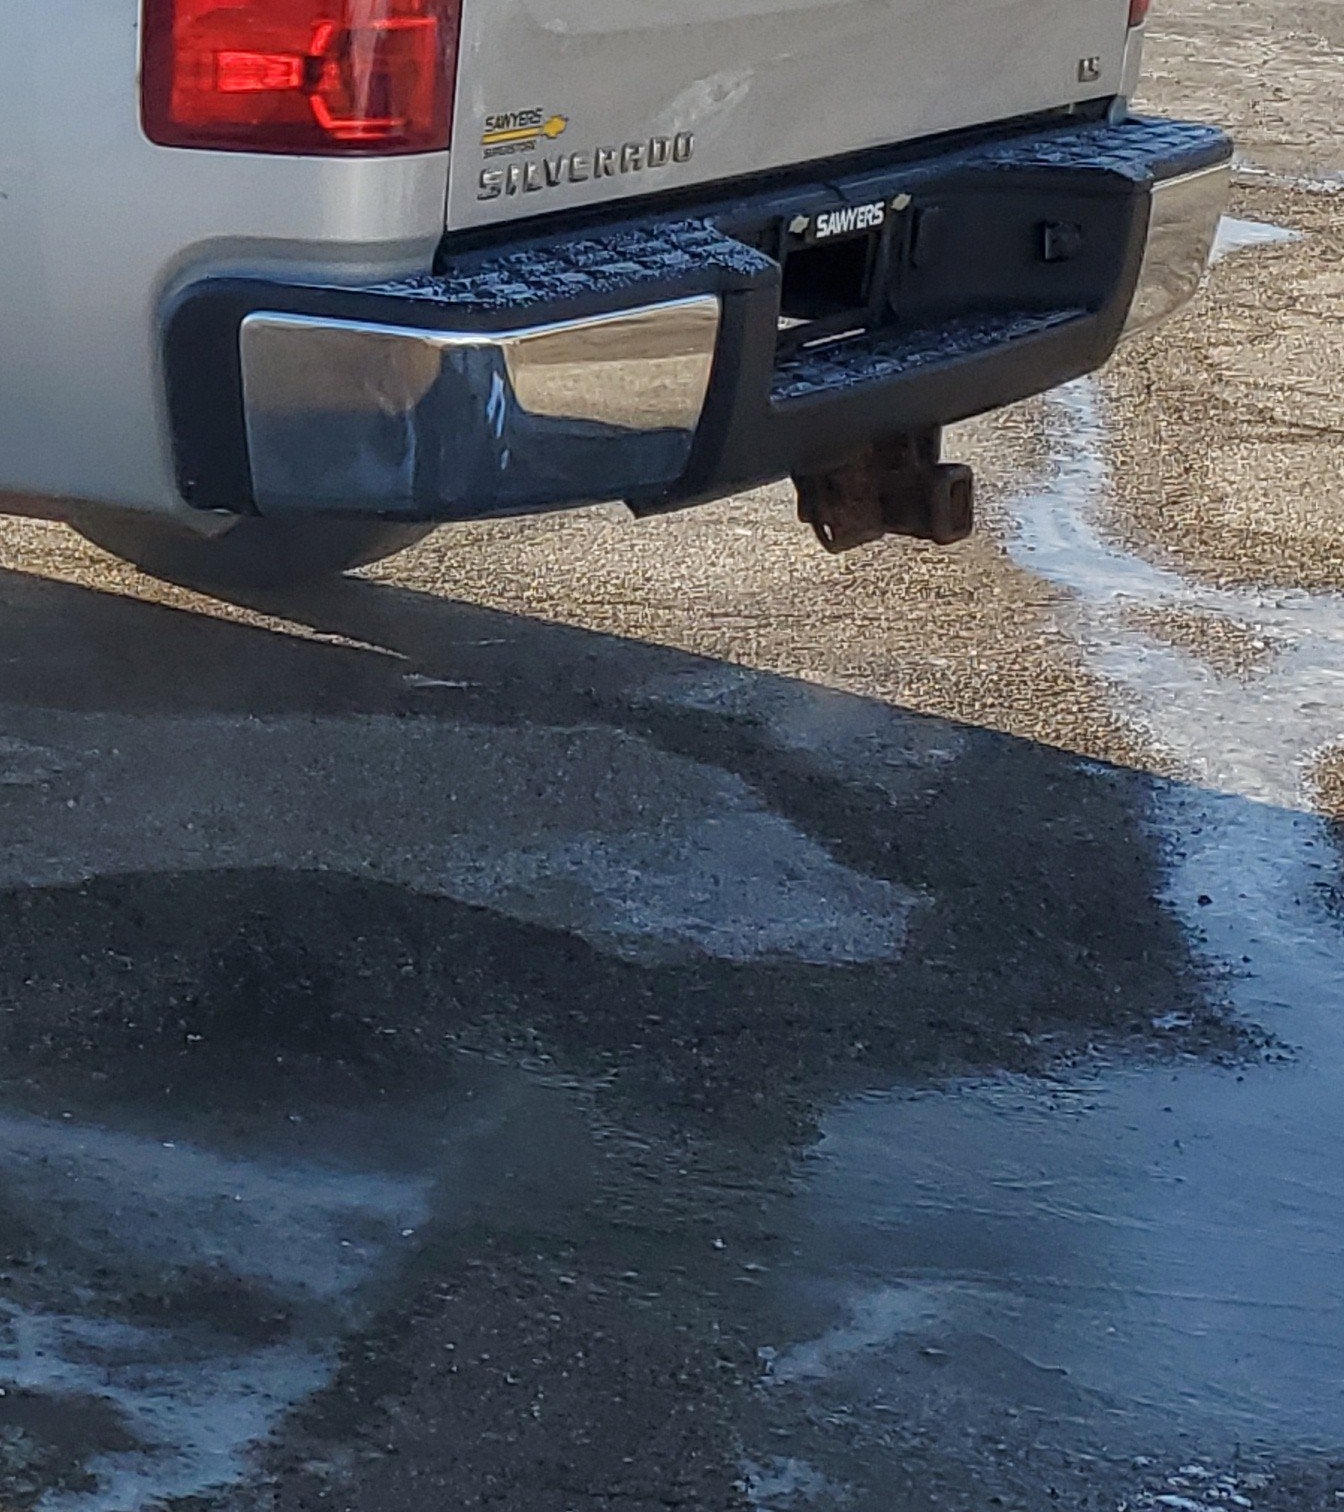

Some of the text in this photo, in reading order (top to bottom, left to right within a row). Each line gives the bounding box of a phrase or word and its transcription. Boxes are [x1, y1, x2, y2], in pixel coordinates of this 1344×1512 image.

[485, 108, 543, 131] SAWYERS
[477, 130, 695, 200] SILVERADO
[816, 201, 885, 238] SAWYERS
